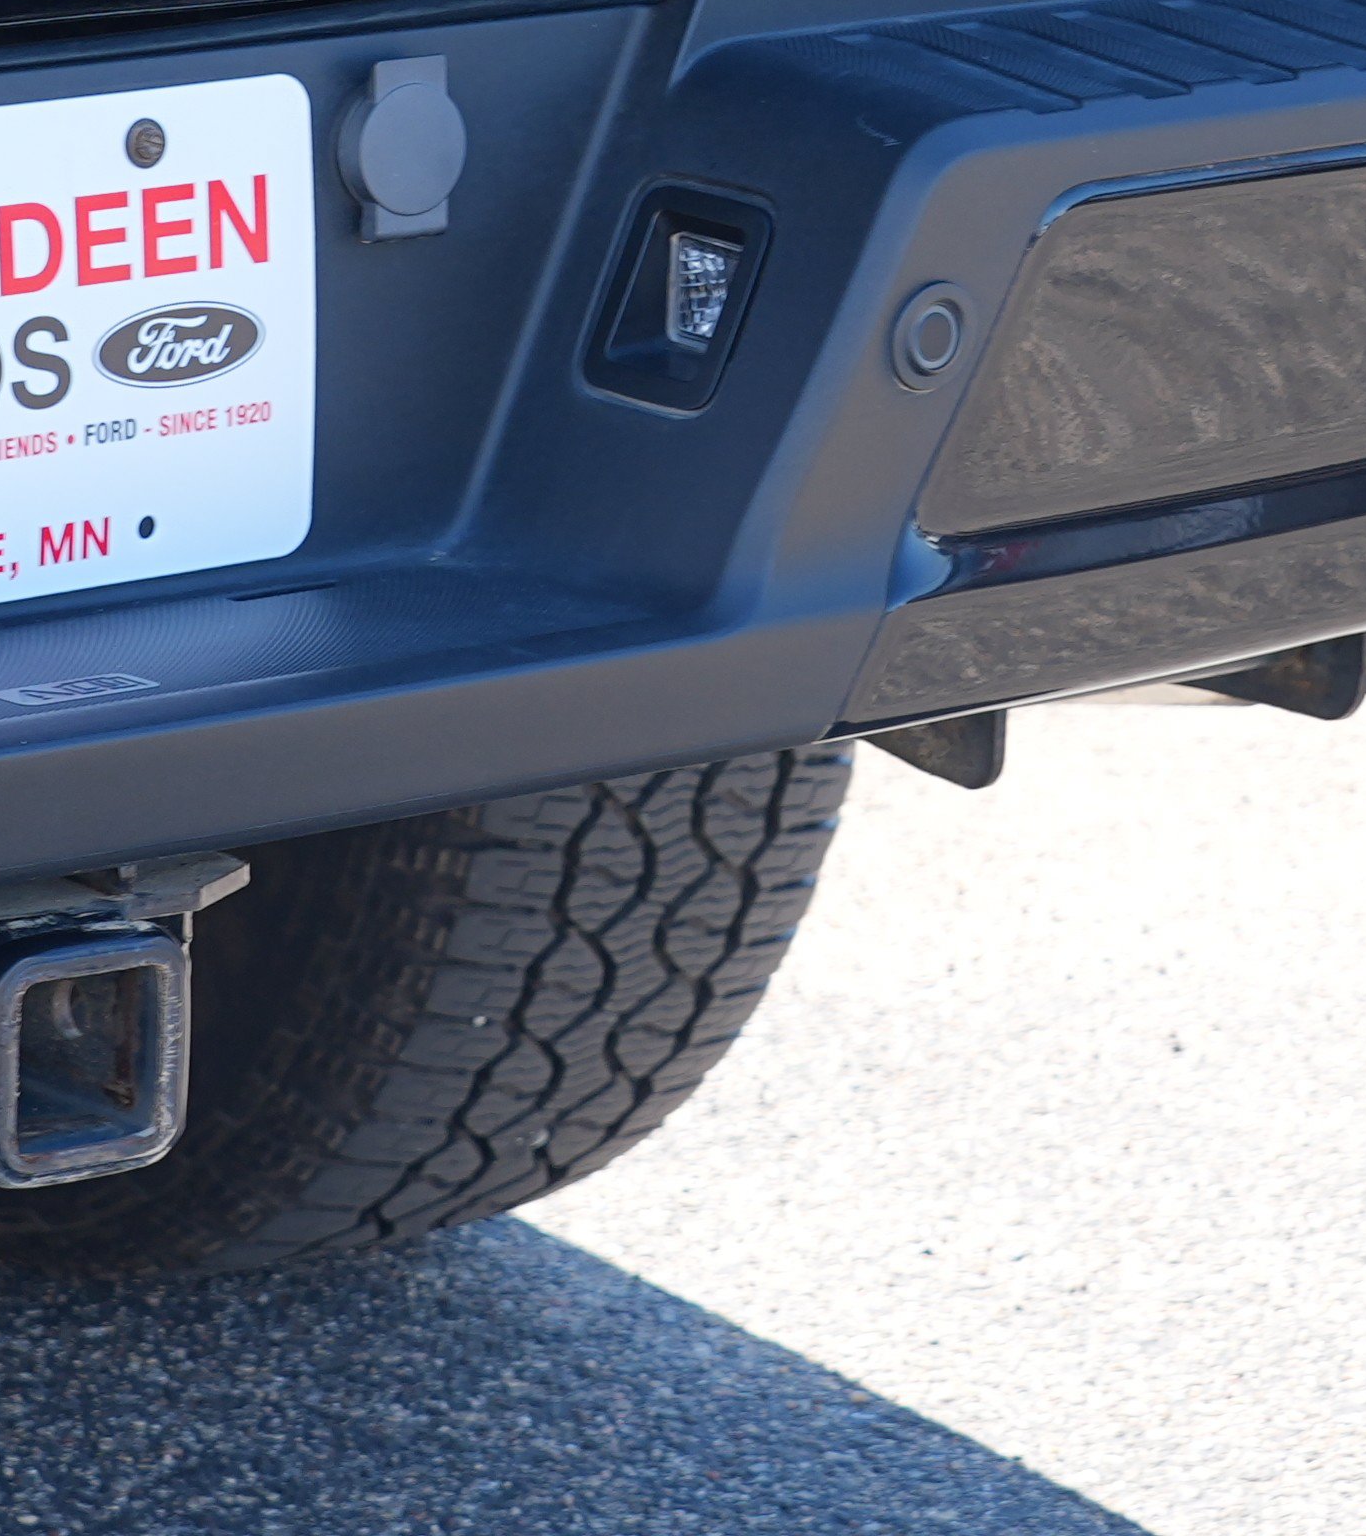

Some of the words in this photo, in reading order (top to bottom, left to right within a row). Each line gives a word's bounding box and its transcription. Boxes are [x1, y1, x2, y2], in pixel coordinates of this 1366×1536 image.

[126, 316, 232, 371] Ford
[85, 419, 137, 447] FORD
[158, 409, 219, 437] SINCE
[226, 401, 272, 427] 1920
[39, 518, 112, 567] MN
